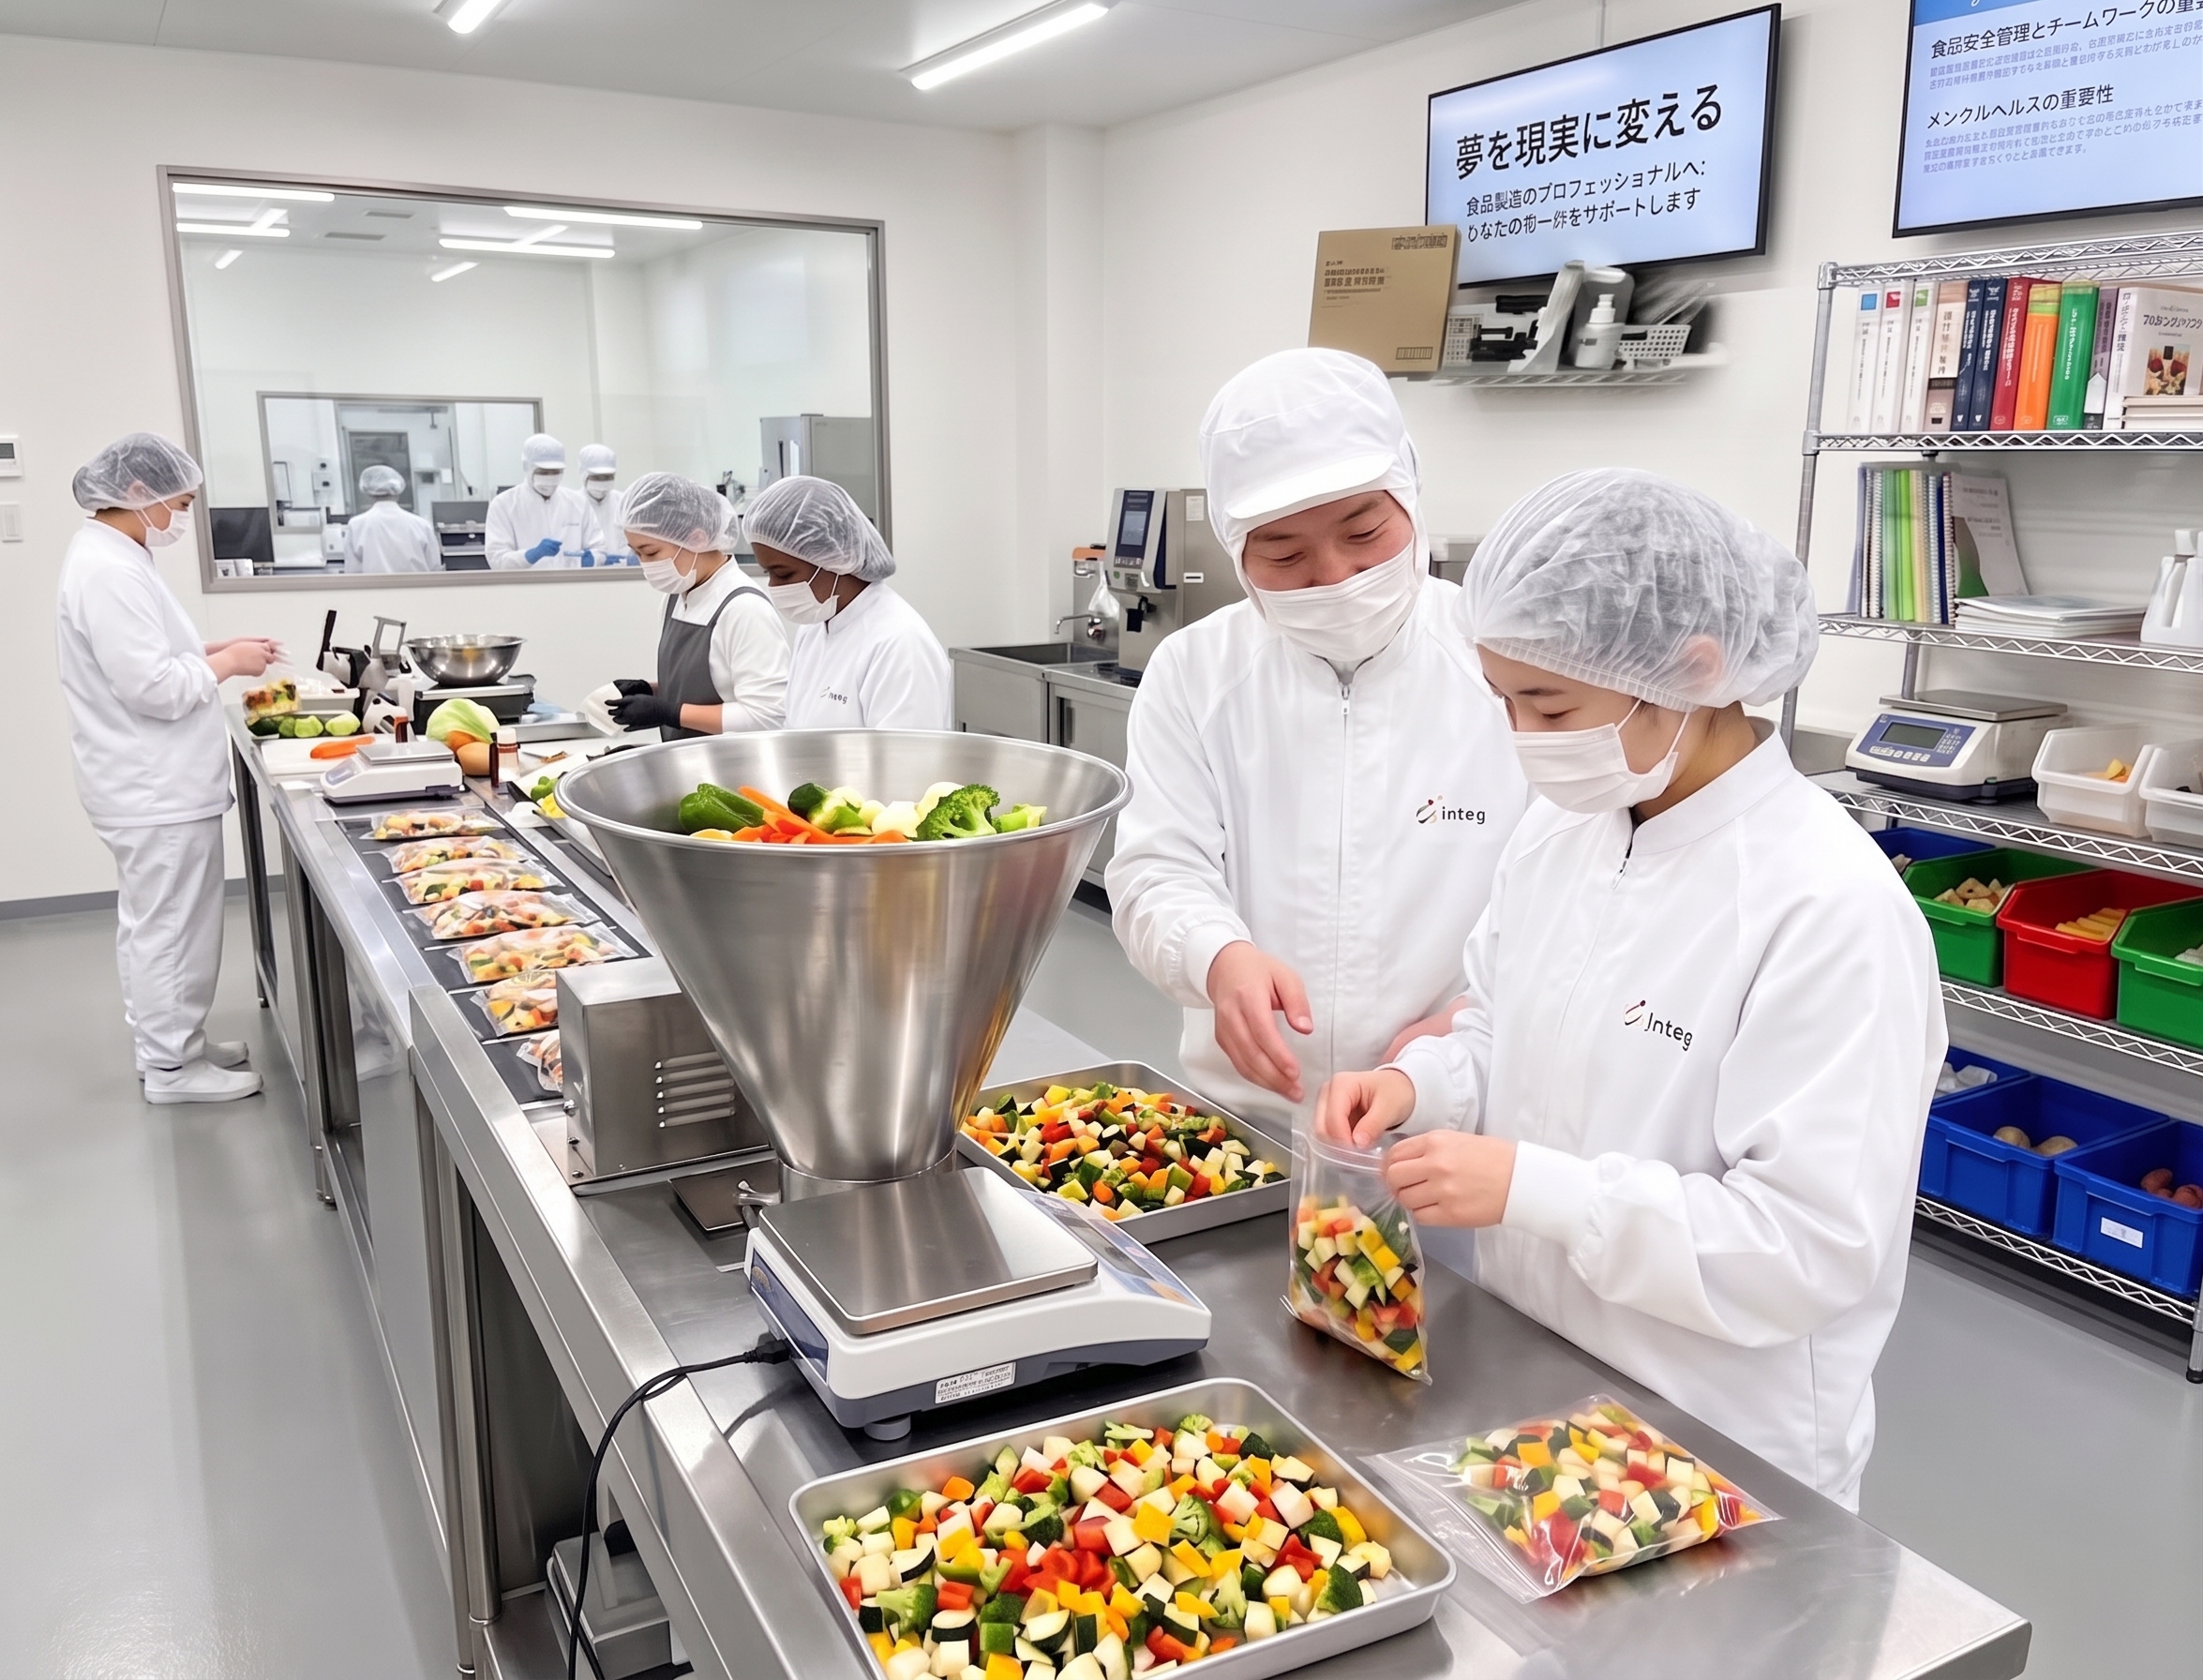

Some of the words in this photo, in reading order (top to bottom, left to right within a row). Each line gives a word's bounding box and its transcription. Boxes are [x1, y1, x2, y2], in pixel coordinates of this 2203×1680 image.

[1930, 0, 2203, 59] 食品安全管理とチームワークの重
[1456, 83, 1722, 180] 夢を現実に変える
[1926, 83, 2115, 129] メンクルヘルスの重要性
[1442, 805, 1486, 825] integ
